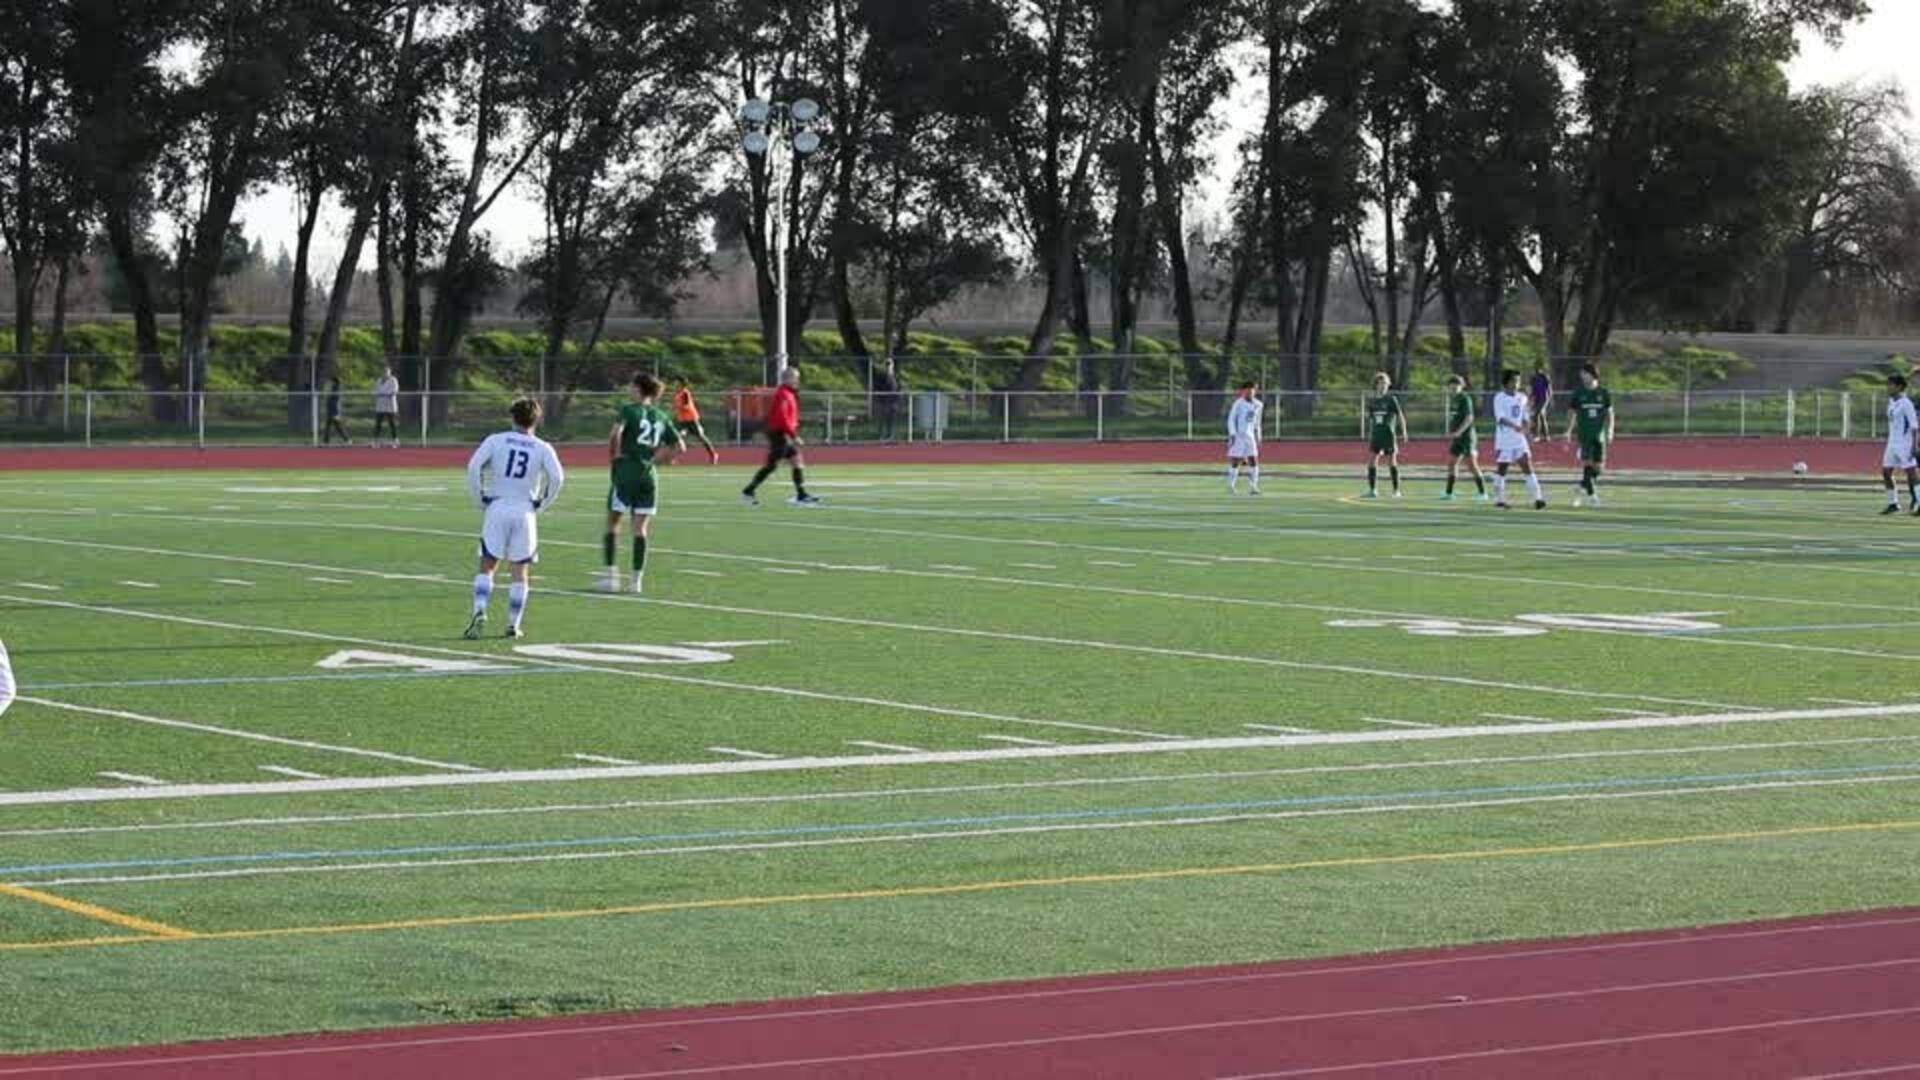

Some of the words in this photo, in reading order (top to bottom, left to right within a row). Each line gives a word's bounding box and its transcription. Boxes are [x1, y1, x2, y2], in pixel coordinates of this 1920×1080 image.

[636, 419, 663, 448] 21
[505, 449, 529, 479] 13
[316, 643, 736, 672] 40
